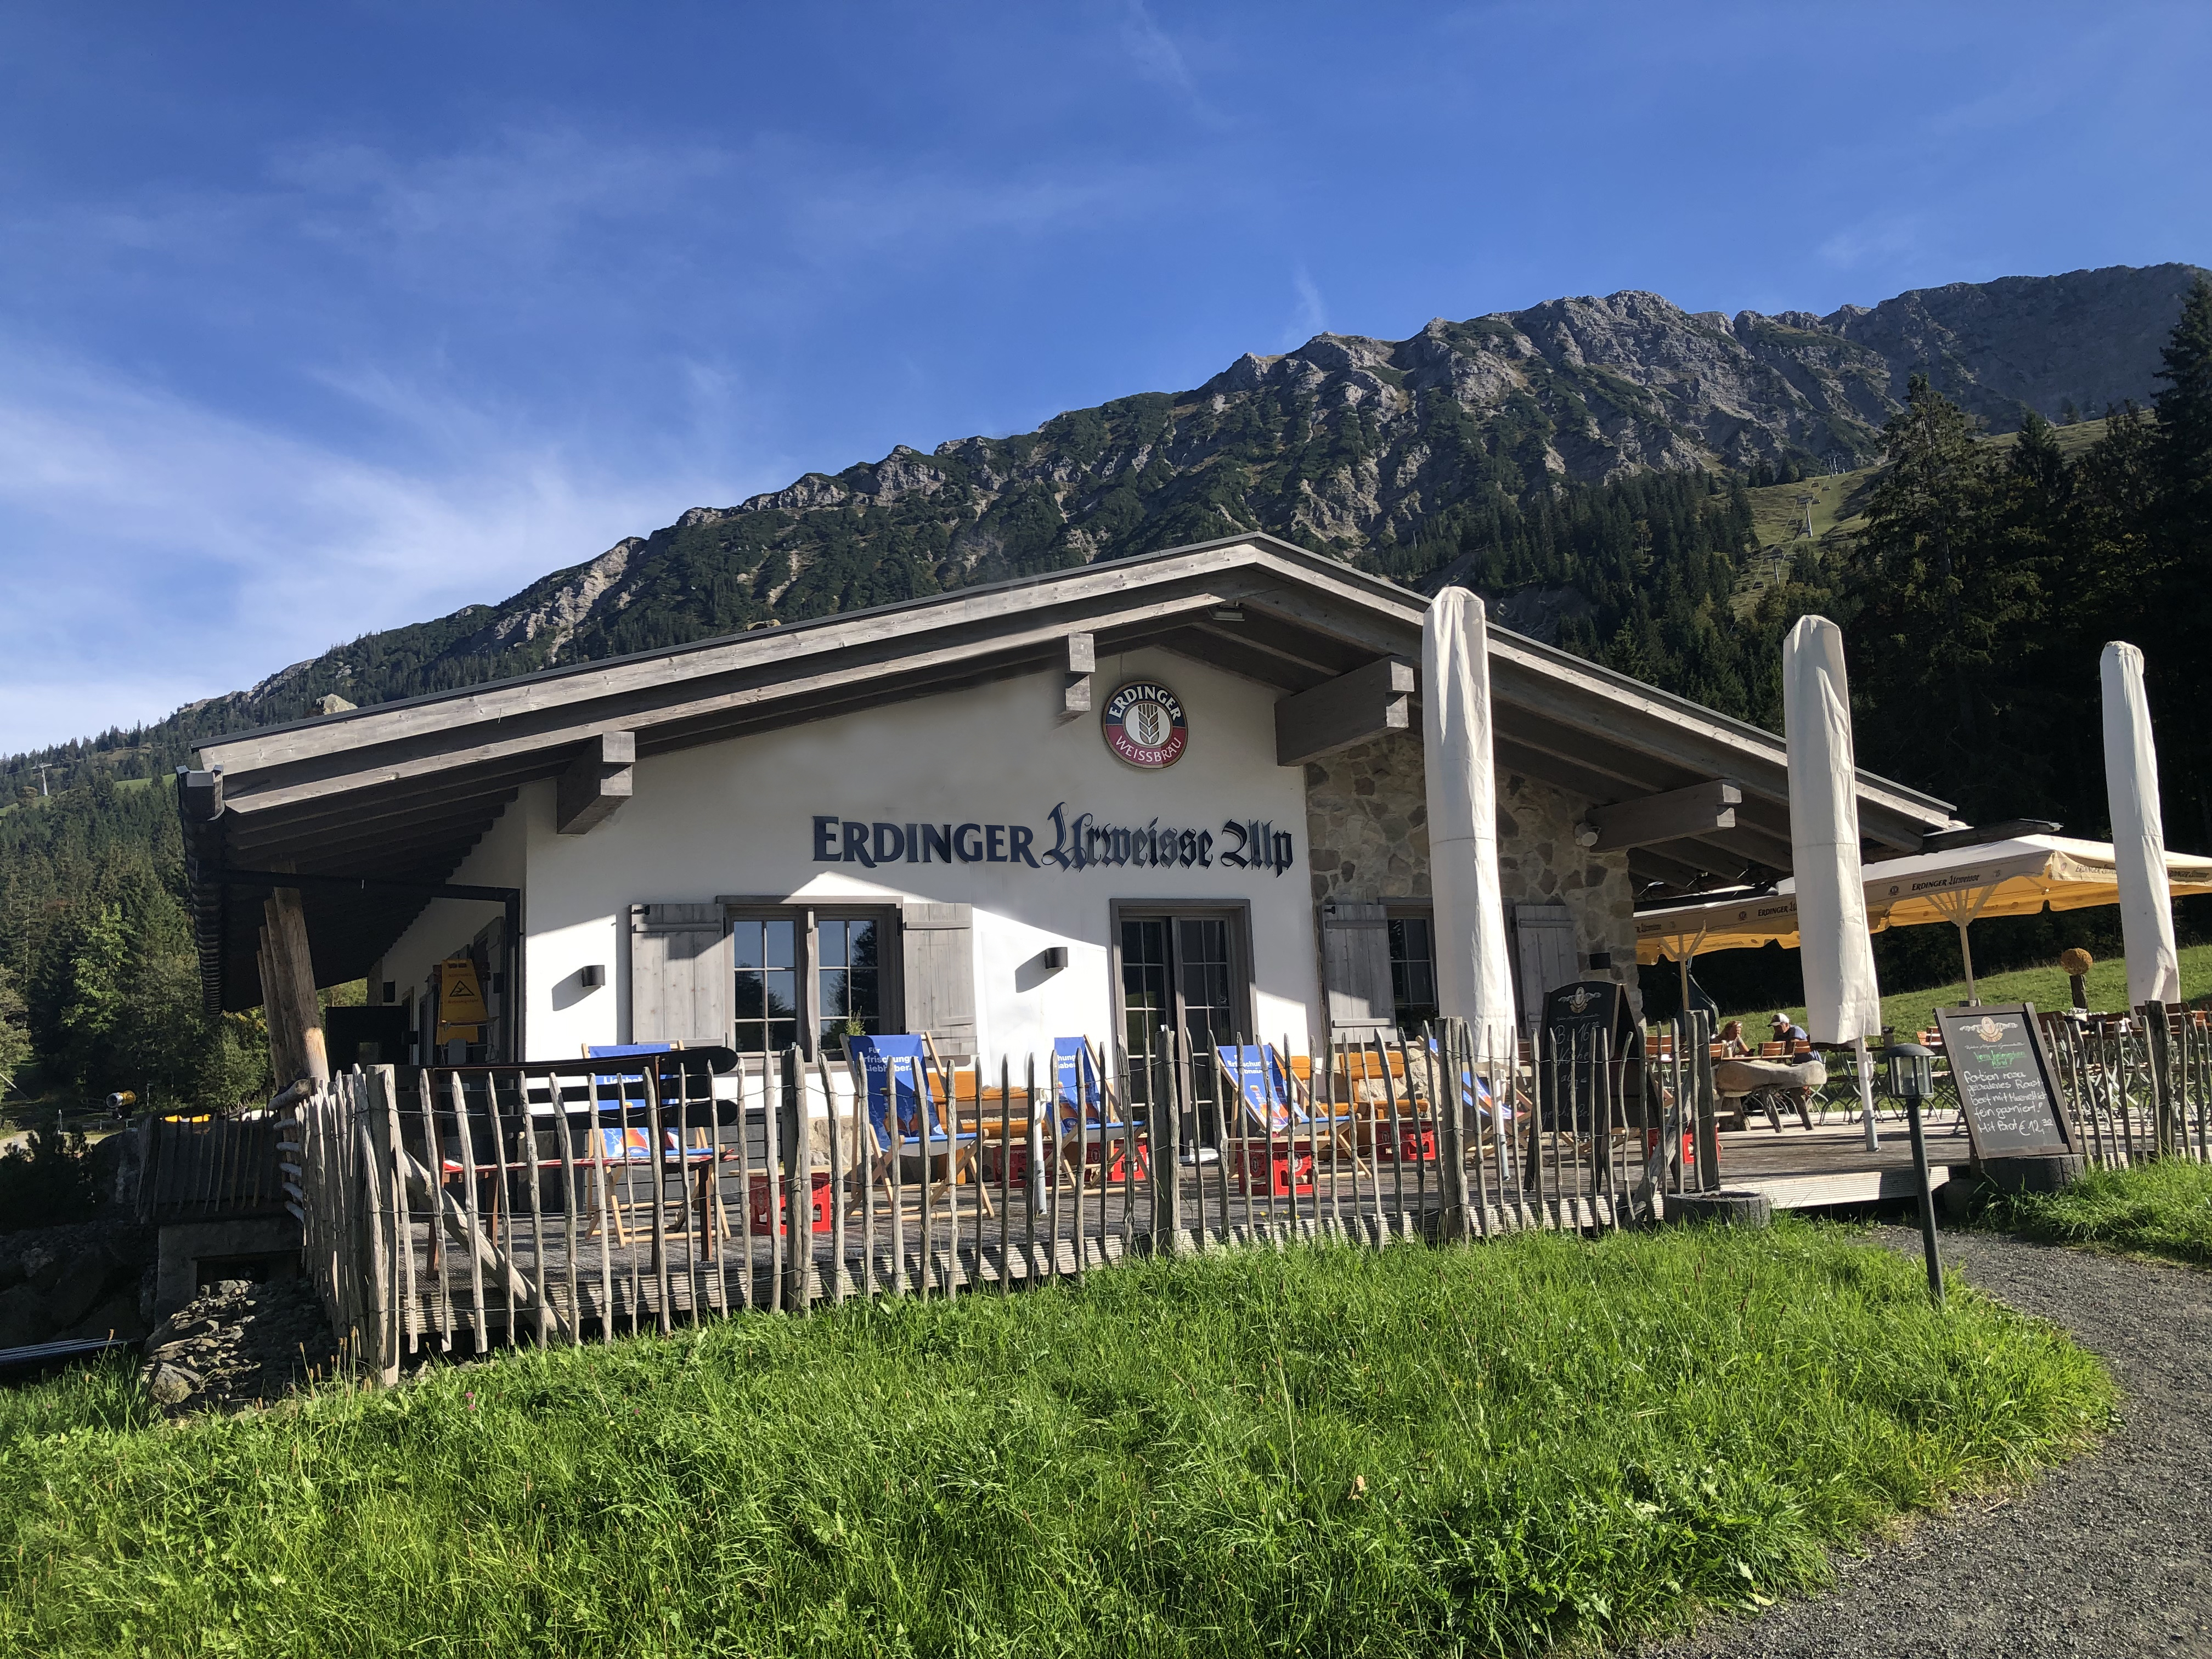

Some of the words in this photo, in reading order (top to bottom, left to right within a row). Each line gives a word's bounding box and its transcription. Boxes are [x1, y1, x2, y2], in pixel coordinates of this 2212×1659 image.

[1108, 686, 1181, 720] ERDINGER
[1115, 735, 1182, 763] WEISSBRÄU
[812, 815, 1041, 868] ERDINGER
[1041, 802, 1214, 873] Urweisse
[1221, 819, 1294, 878] Alp
[1911, 879, 1947, 891] ERDINGER
[1758, 905, 1788, 917] ERDINGER
[2003, 1071, 2026, 1080] rosa
[1993, 1092, 2007, 1102] mit
[1973, 1107, 1995, 1122] fein
[1996, 1101, 2043, 1119] garniert!
[1978, 1121, 1995, 1133] Mit
[1997, 1119, 2018, 1132] Brot
